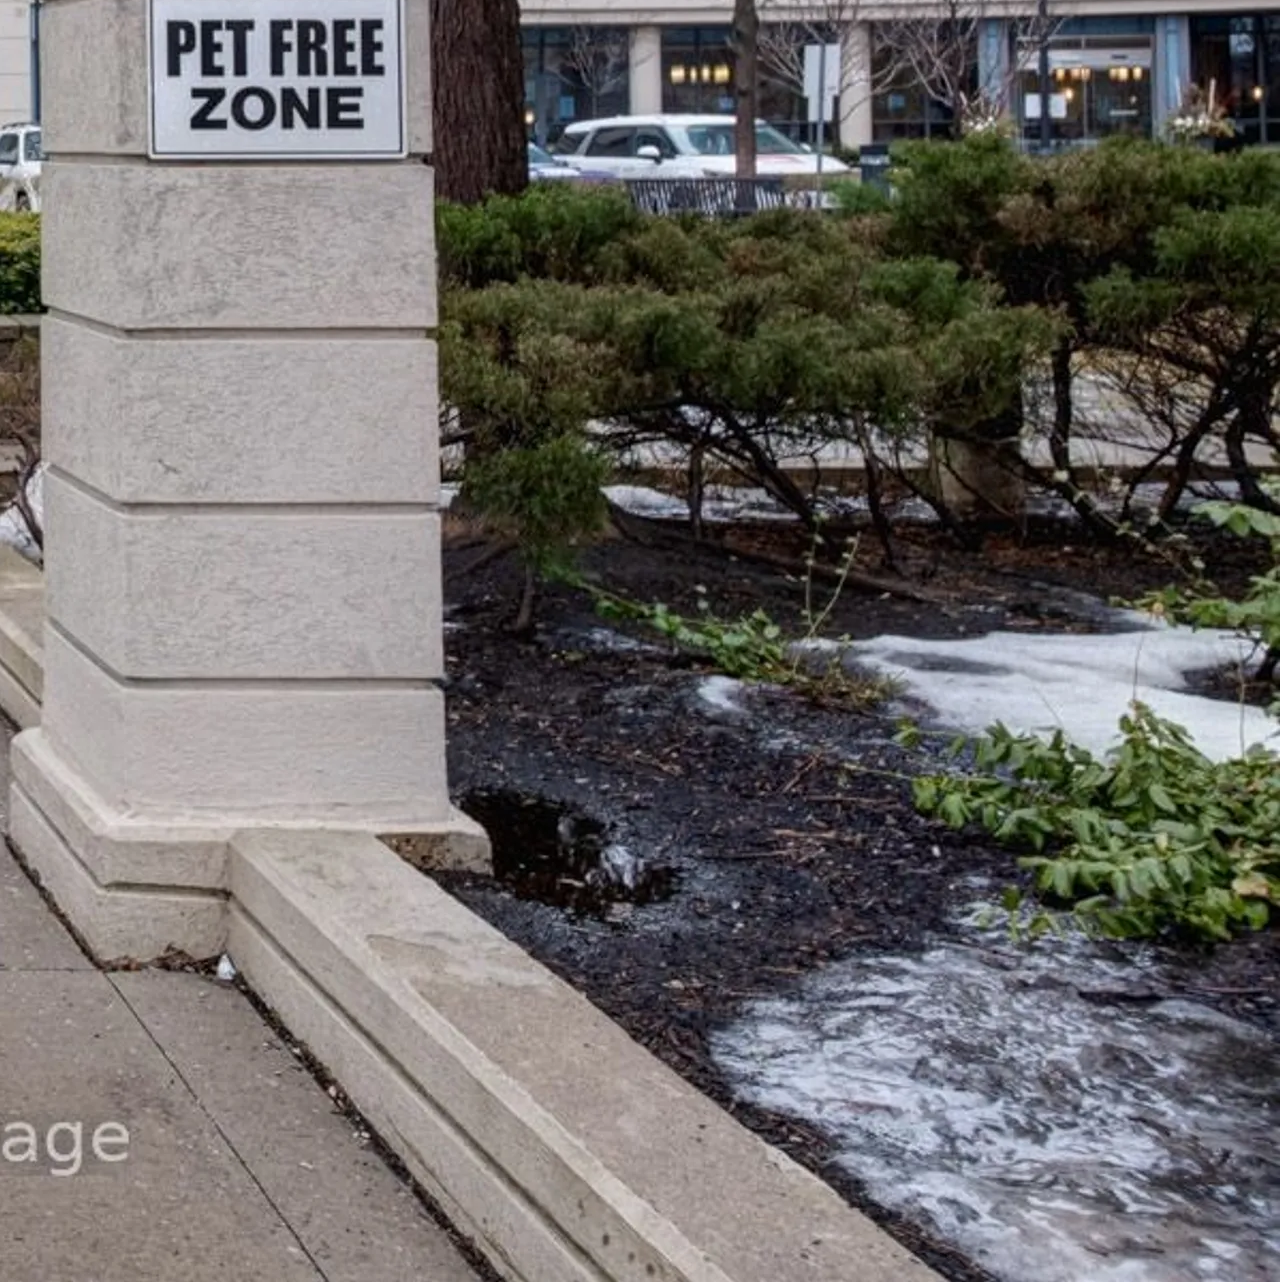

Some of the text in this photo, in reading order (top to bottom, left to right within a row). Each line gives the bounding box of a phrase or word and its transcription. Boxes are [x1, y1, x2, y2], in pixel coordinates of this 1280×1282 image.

[166, 19, 385, 77] PET FREE
[190, 85, 364, 131] ZONE
